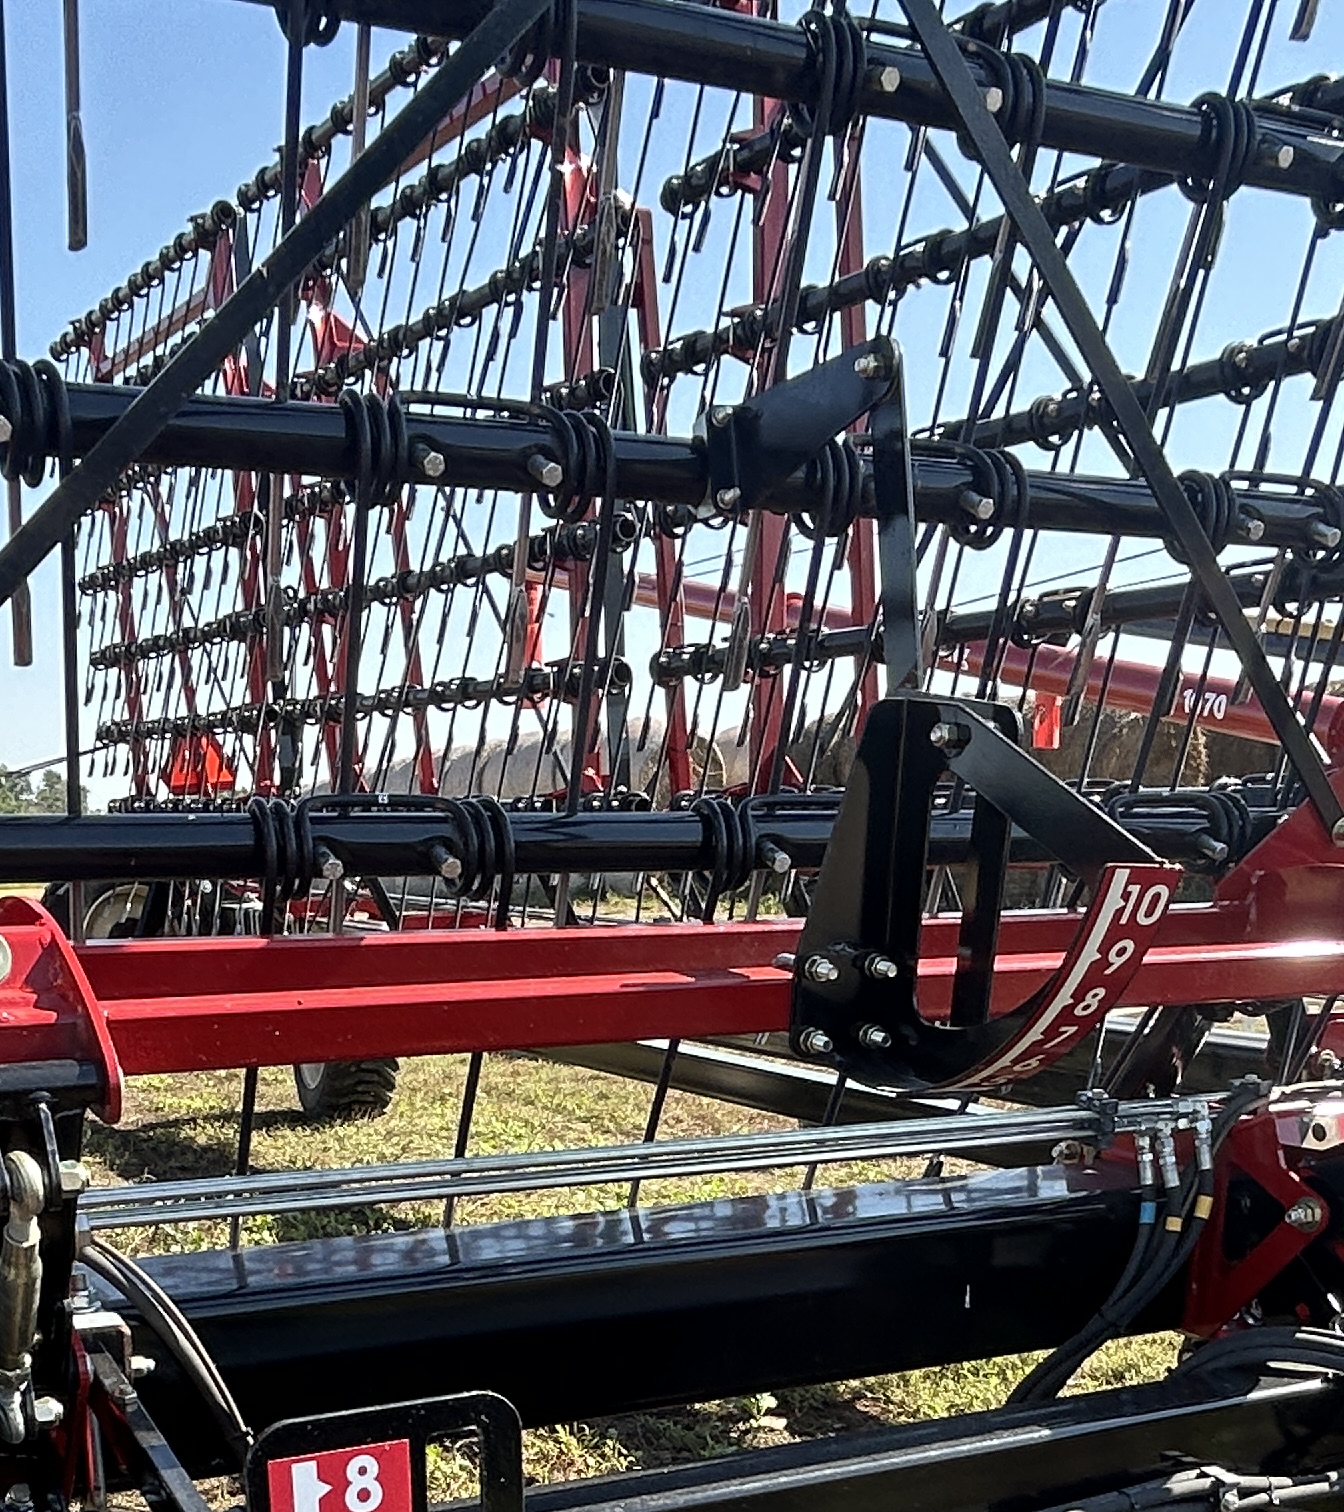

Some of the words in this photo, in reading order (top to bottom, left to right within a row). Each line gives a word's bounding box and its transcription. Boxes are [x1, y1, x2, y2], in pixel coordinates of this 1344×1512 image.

[1183, 689, 1227, 720] 170
[1119, 884, 1170, 926] 10
[1103, 938, 1135, 975] 9
[1074, 987, 1106, 1017] 8
[1043, 1026, 1079, 1049] 7
[1013, 1054, 1045, 1071] 6
